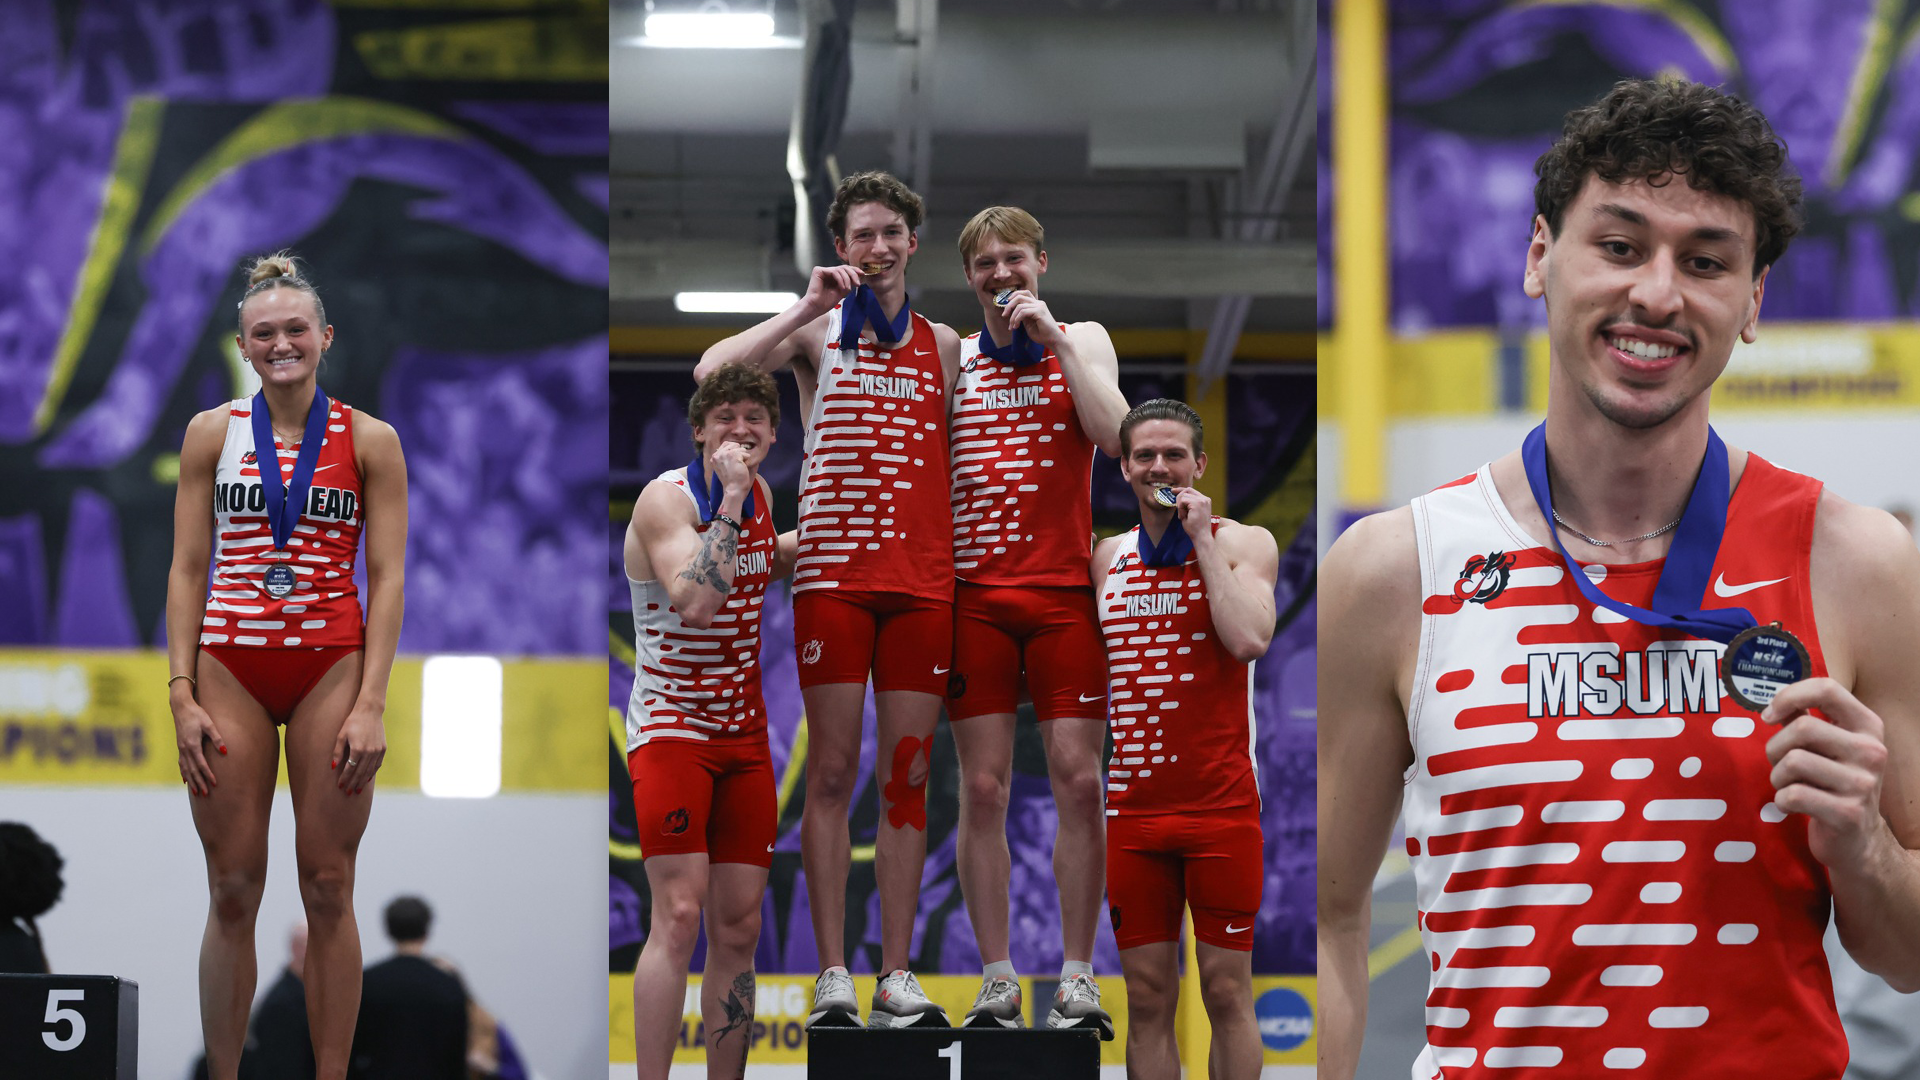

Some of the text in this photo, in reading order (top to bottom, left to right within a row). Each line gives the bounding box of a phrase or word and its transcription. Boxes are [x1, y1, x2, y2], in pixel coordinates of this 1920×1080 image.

[859, 373, 916, 400] MSUM
[982, 385, 1040, 410] MSUM
[216, 483, 356, 520] MOOEAD
[1126, 592, 1178, 617] MSUM
[1757, 636, 1788, 648] 3rd Place
[1527, 649, 1720, 718] MSUM
[1738, 663, 1794, 679] CHAMPIONSHIPS
[41, 989, 87, 1051] 5
[938, 1040, 962, 1080] 1
